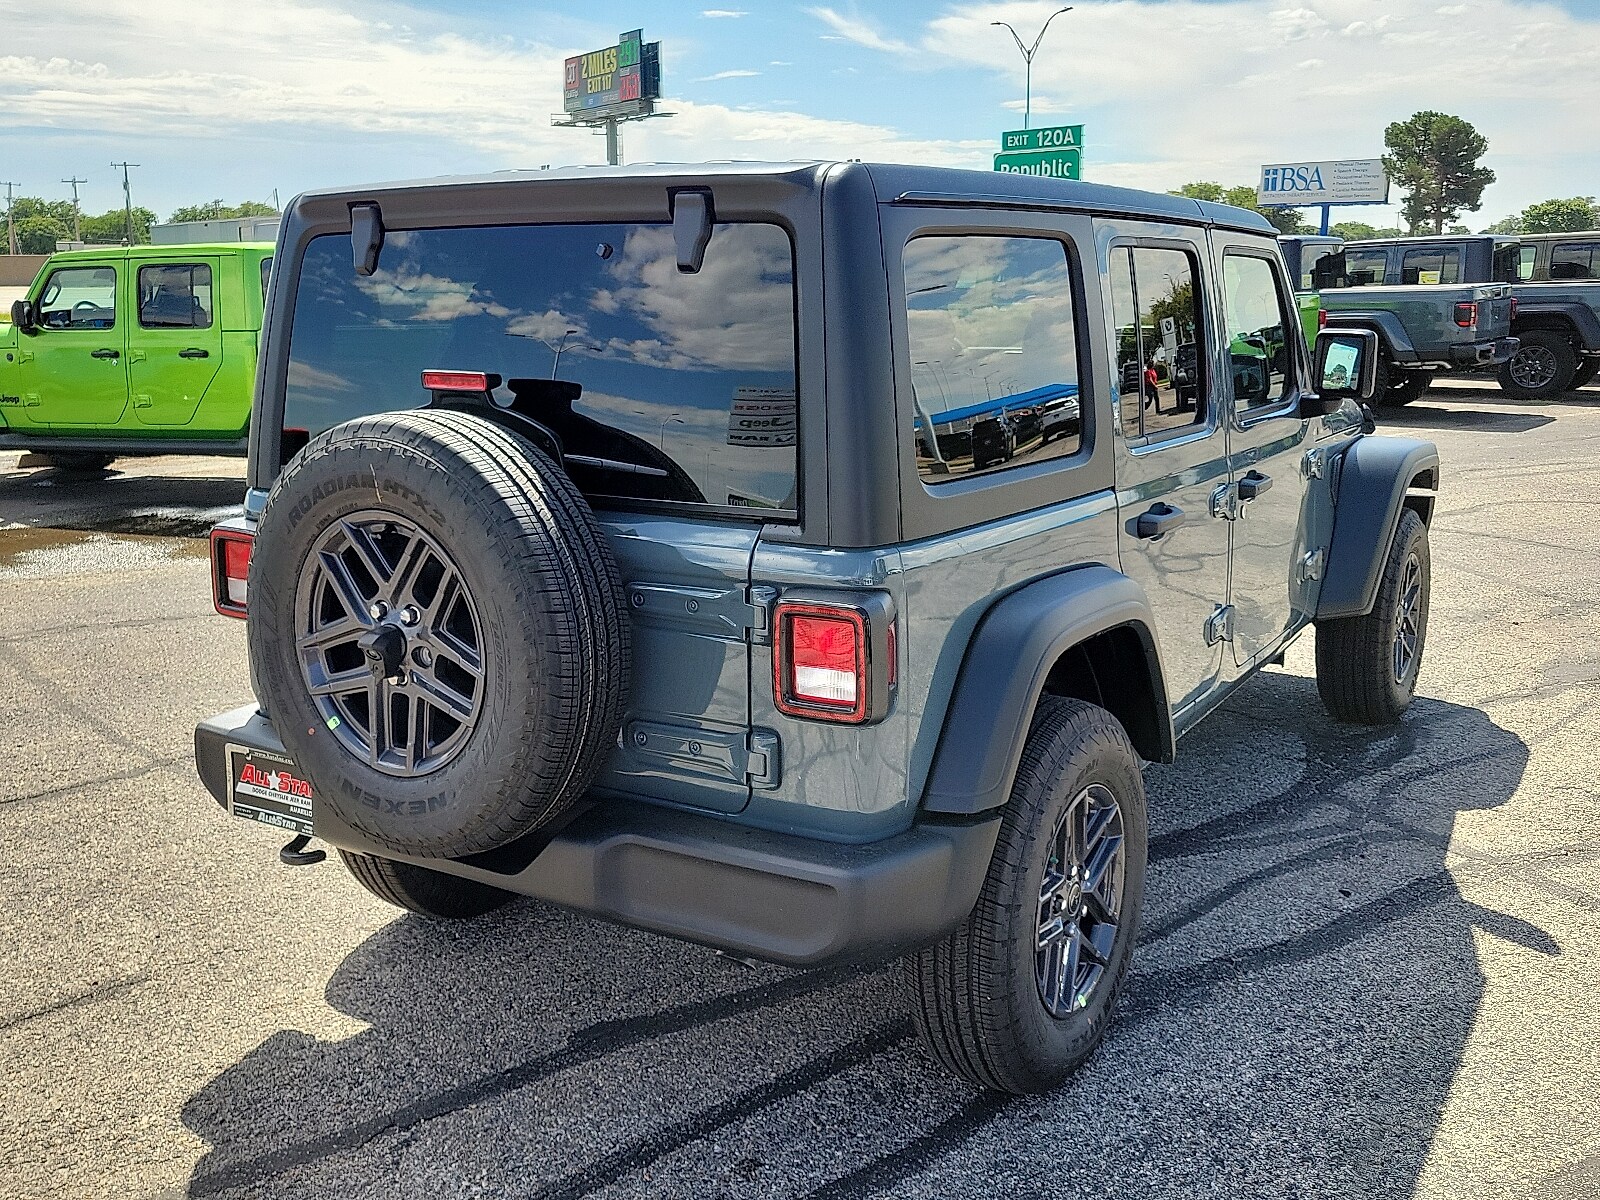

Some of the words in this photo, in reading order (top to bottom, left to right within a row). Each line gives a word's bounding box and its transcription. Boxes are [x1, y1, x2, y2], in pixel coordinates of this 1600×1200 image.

[581, 56, 588, 79] 2
[588, 48, 617, 77] MILES
[587, 76, 601, 94] EXIT
[1007, 134, 1029, 147] EXIT
[1036, 128, 1074, 147] 120A
[1278, 165, 1326, 192] BSA
[340, 778, 448, 816] NEXEN
